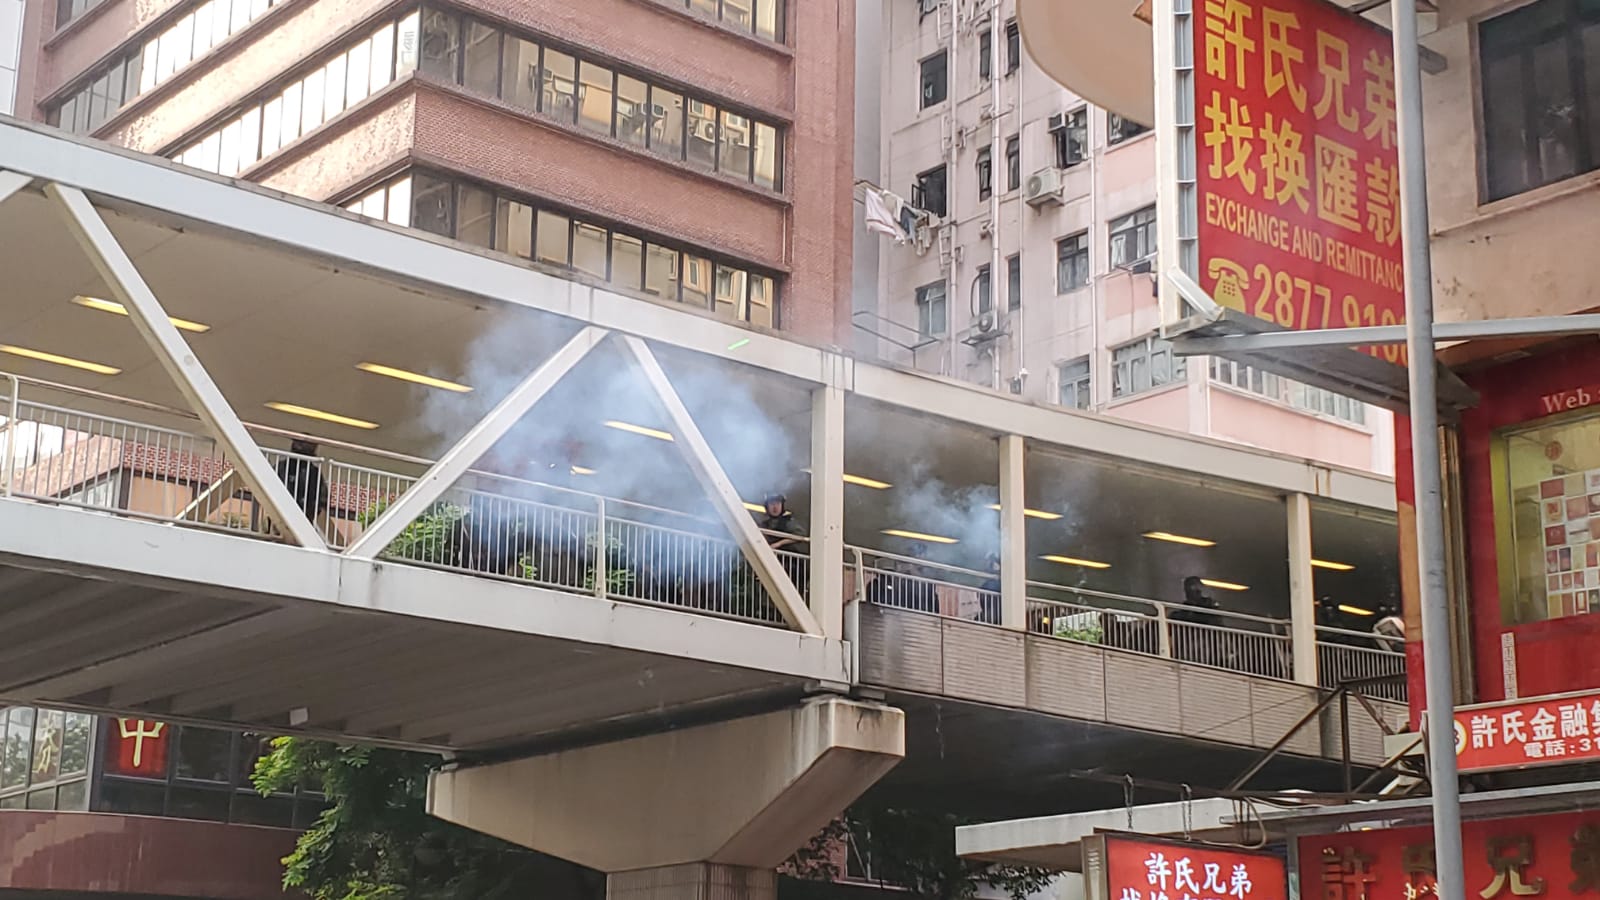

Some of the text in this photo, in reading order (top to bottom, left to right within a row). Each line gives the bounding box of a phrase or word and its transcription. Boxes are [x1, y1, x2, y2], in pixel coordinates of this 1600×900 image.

[1205, 0, 1397, 150] 許氏兄弟
[1204, 90, 1401, 247] 找換匯款
[1206, 192, 1404, 293] EXCHANGE AND REMITTANC
[1253, 263, 1408, 367] 2877 910
[1541, 388, 1591, 414] Web
[1144, 852, 1252, 900] 許氏兄弟
